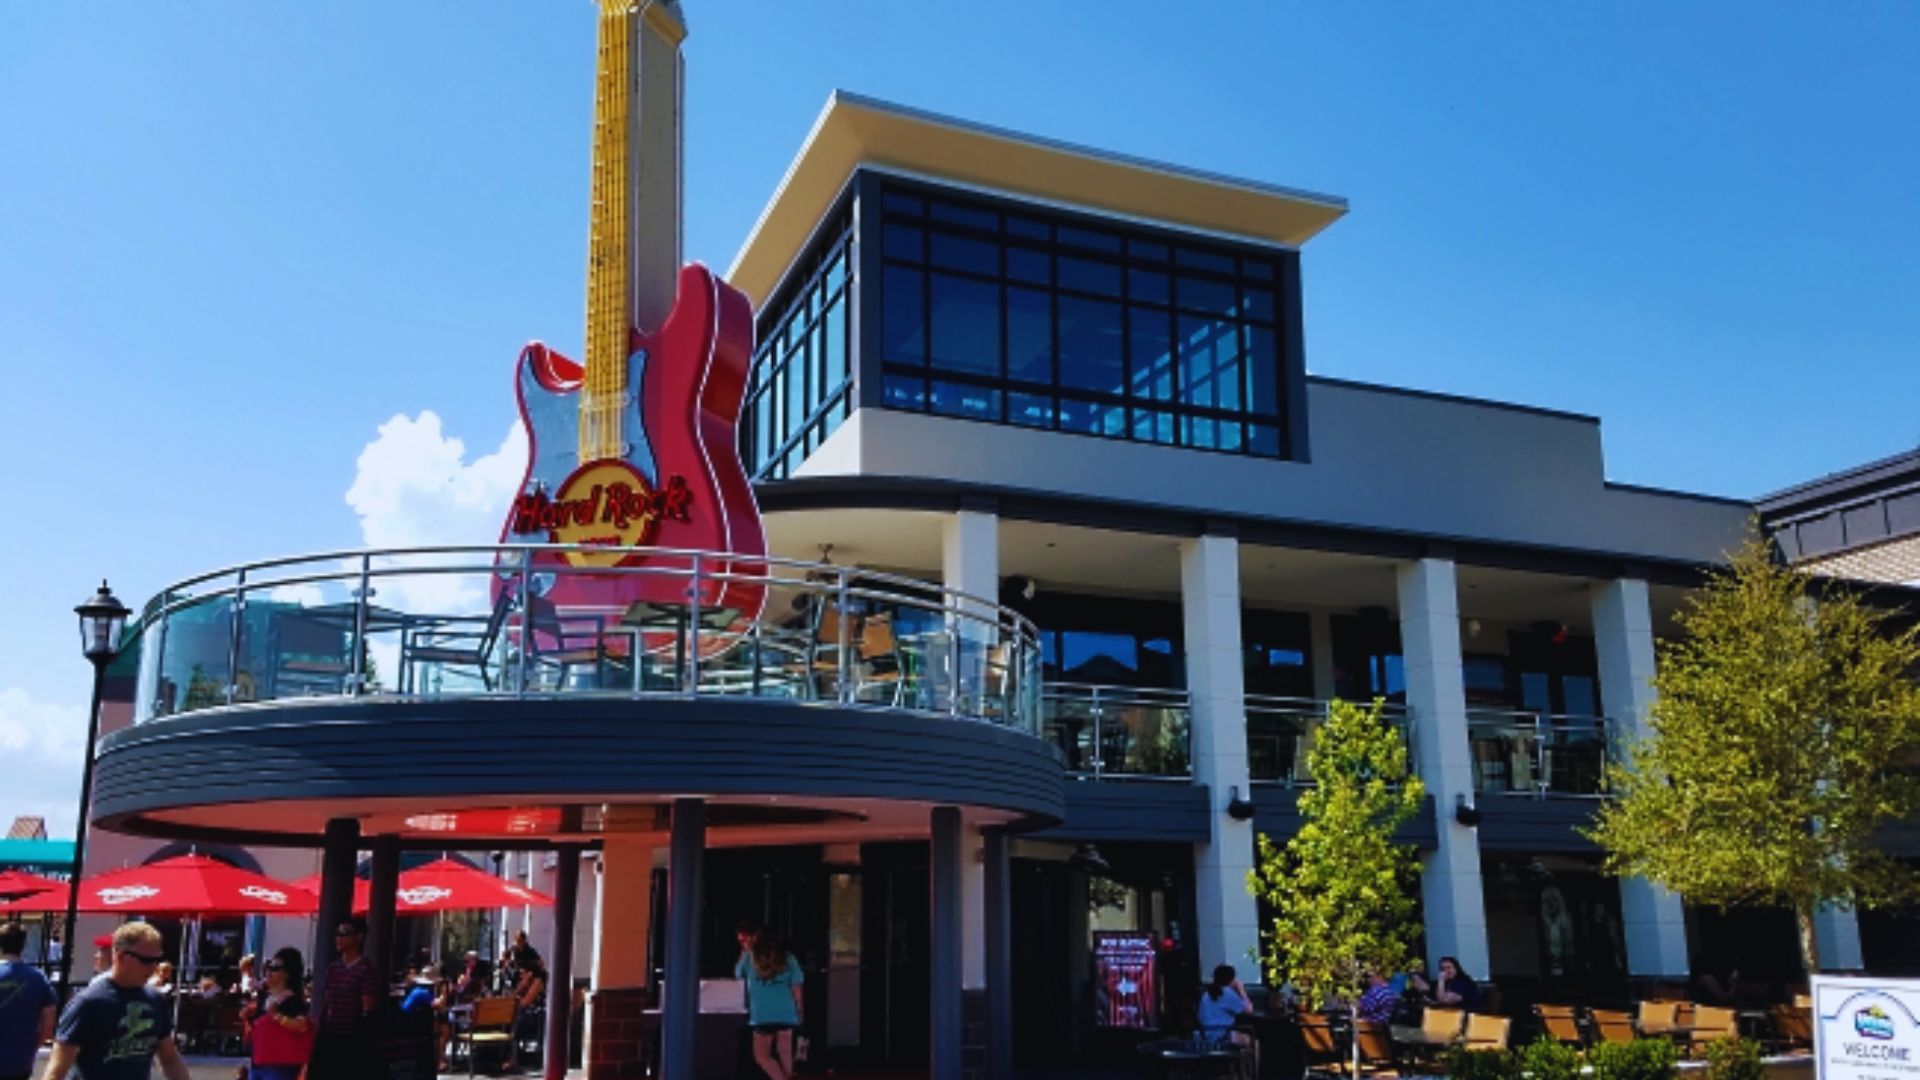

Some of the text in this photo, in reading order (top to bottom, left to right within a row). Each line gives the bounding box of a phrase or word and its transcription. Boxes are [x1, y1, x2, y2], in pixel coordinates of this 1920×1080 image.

[513, 475, 694, 535] Hard Rock
[1843, 1043, 1911, 1061] WELCOME
